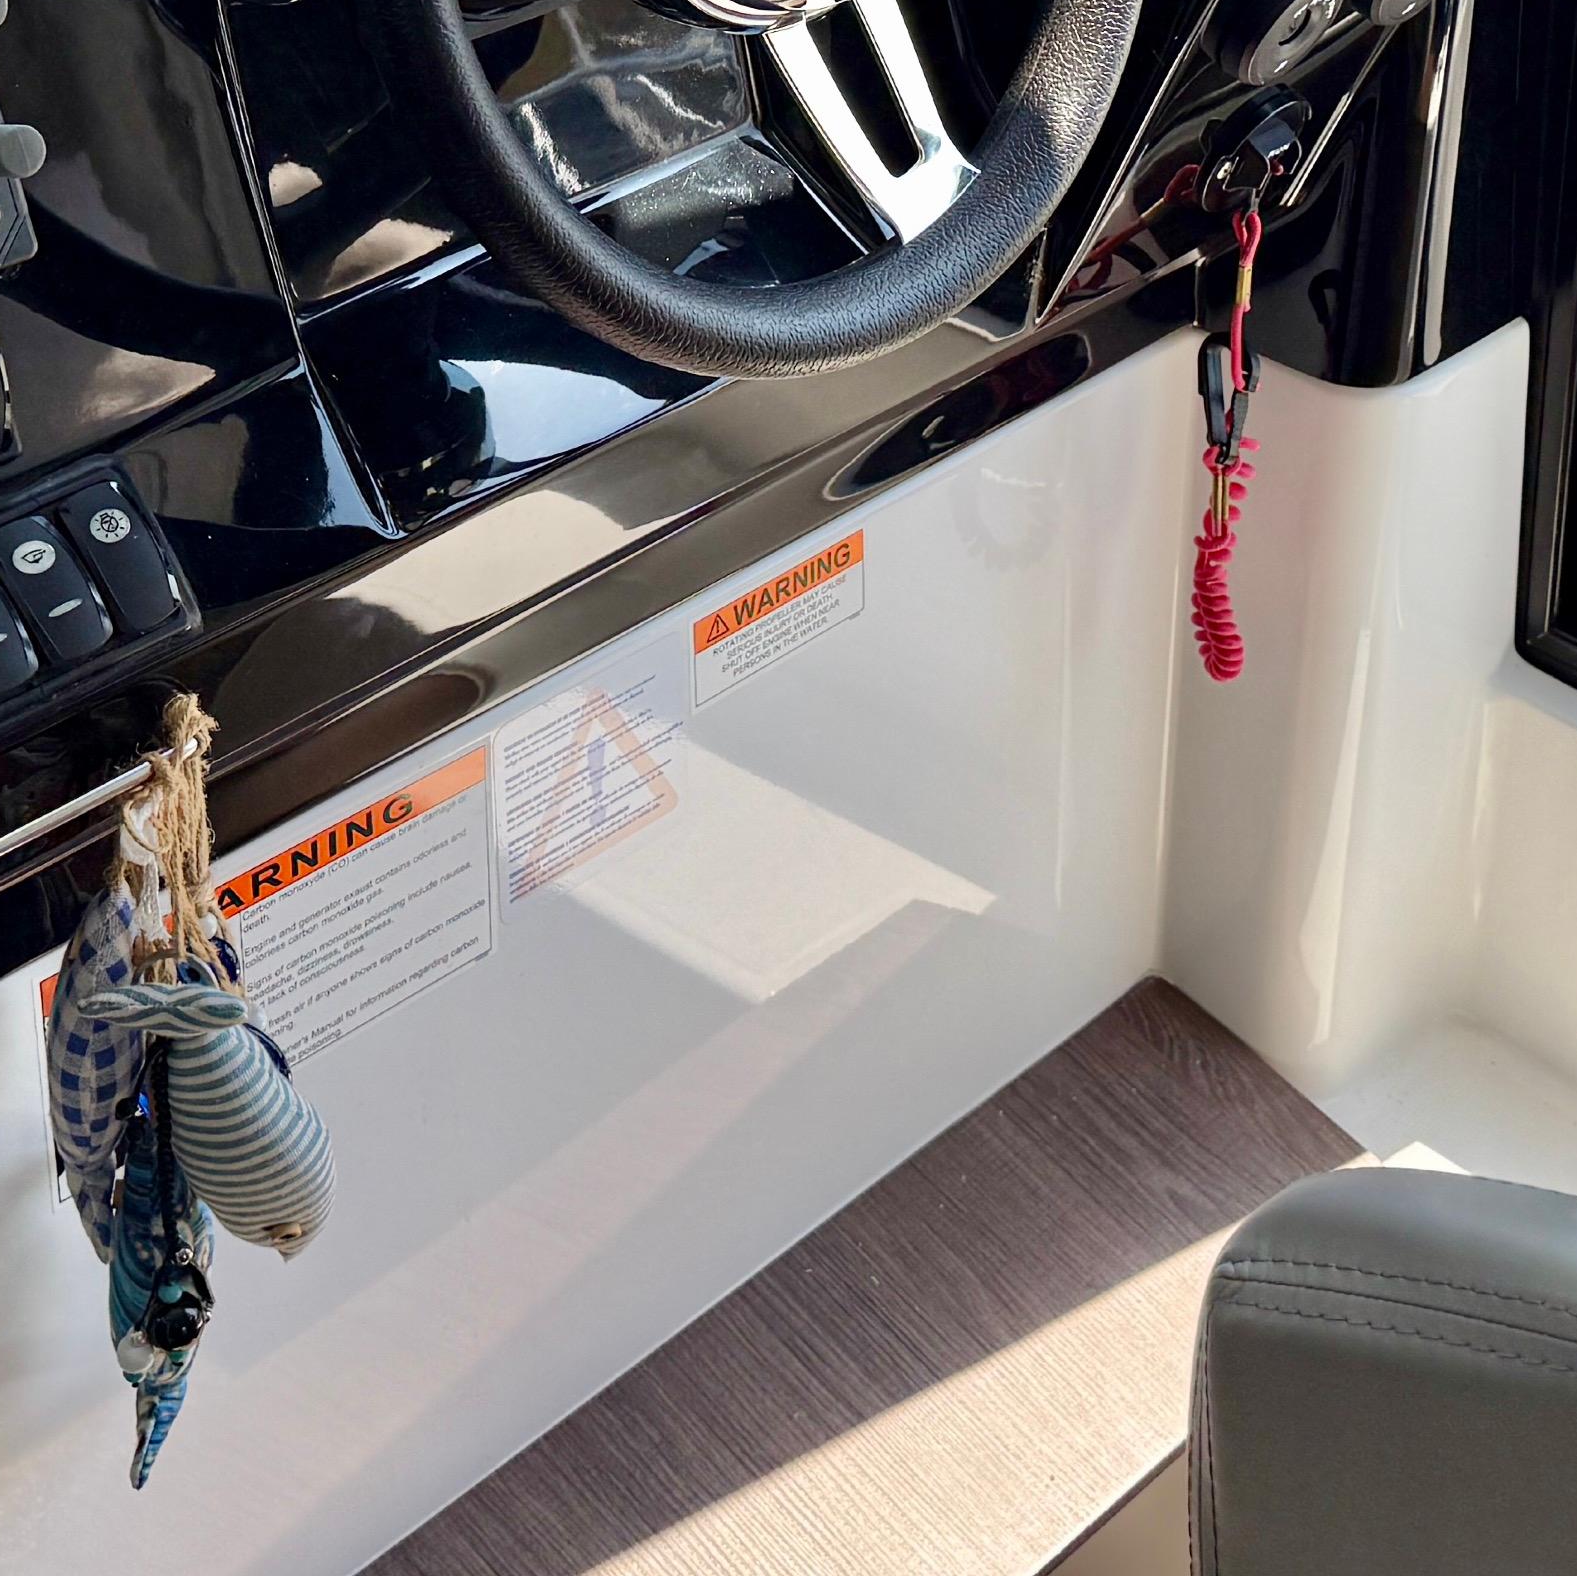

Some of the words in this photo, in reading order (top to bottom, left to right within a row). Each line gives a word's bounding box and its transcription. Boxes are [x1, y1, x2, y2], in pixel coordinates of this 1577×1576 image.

[733, 543, 851, 625] WARNING
[713, 625, 755, 657] ROTATING
[755, 600, 802, 633] PROPELLER
[721, 654, 743, 673] SHUT
[745, 645, 761, 660] OFF
[762, 625, 793, 651] ENGINE
[727, 632, 763, 660] SERIOUS
[764, 615, 792, 641] INJURY
[793, 608, 805, 621] OR
[733, 648, 772, 677] PERSONS
[773, 643, 782, 654] IN
[784, 632, 799, 647] THE
[218, 793, 413, 911] ARNING
[242, 898, 276, 921] Carbon
[328, 857, 350, 877] (CO)
[352, 848, 368, 862] can
[370, 832, 397, 852] cause
[399, 820, 421, 837] brain
[244, 935, 277, 958] Engine
[279, 923, 297, 939] and
[298, 898, 342, 928] generator
[375, 860, 411, 885] contains
[413, 839, 449, 864] odorless
[451, 827, 467, 843] and
[245, 942, 286, 969] colorless
[288, 923, 319, 945] carbon
[321, 897, 365, 926] monoxide
[246, 973, 273, 994] Signs
[274, 964, 284, 977] of
[286, 948, 317, 970] carbon
[319, 923, 363, 952] monoxide
[364, 897, 406, 928] poisoning
[408, 879, 439, 901] include
[268, 1009, 292, 1028] fresh
[293, 1000, 306, 1015] air
[315, 978, 348, 1003] anyone
[350, 961, 378, 982] shows
[379, 946, 403, 965] signs
[404, 937, 414, 951] of
[414, 923, 444, 945] carbon
[445, 898, 486, 926] monoxide
[267, 989, 286, 1006] lack
[288, 981, 298, 994] of
[284, 1034, 309, 1055] ner's
[311, 1013, 344, 1039] Manual
[346, 1006, 358, 1019] for
[359, 977, 408, 1011] information
[408, 953, 449, 982] regarding
[451, 935, 480, 958] carbon
